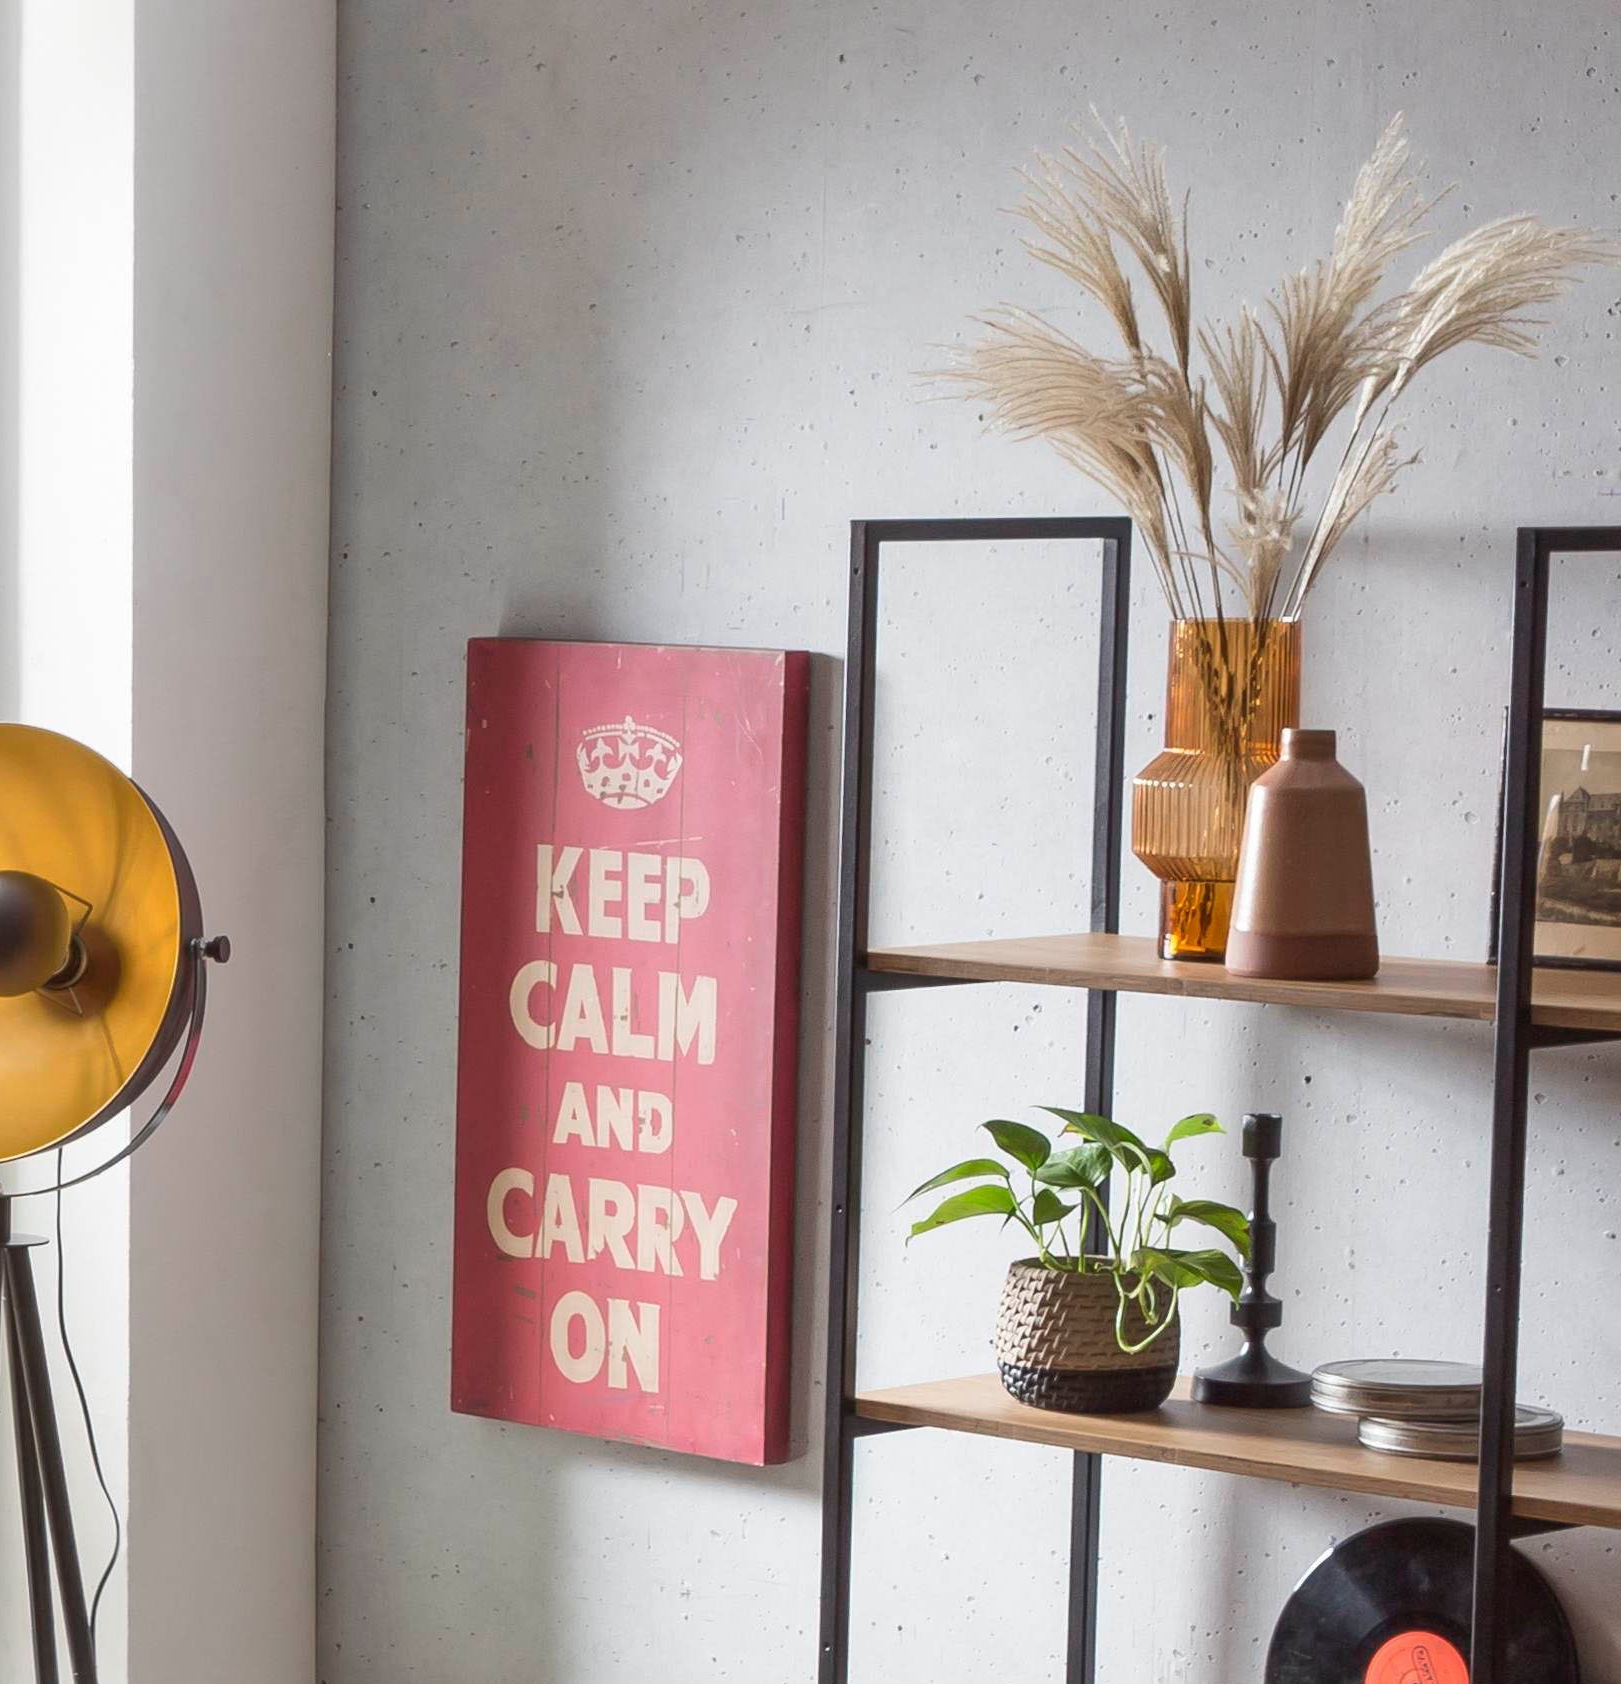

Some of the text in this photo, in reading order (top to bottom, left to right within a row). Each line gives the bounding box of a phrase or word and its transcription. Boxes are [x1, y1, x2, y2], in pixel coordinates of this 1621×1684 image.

[536, 843, 711, 943] KEEP
[509, 960, 717, 1066] CALM
[552, 1082, 674, 1155] AND
[486, 1168, 738, 1281] CARRY
[550, 1290, 661, 1394] ON
